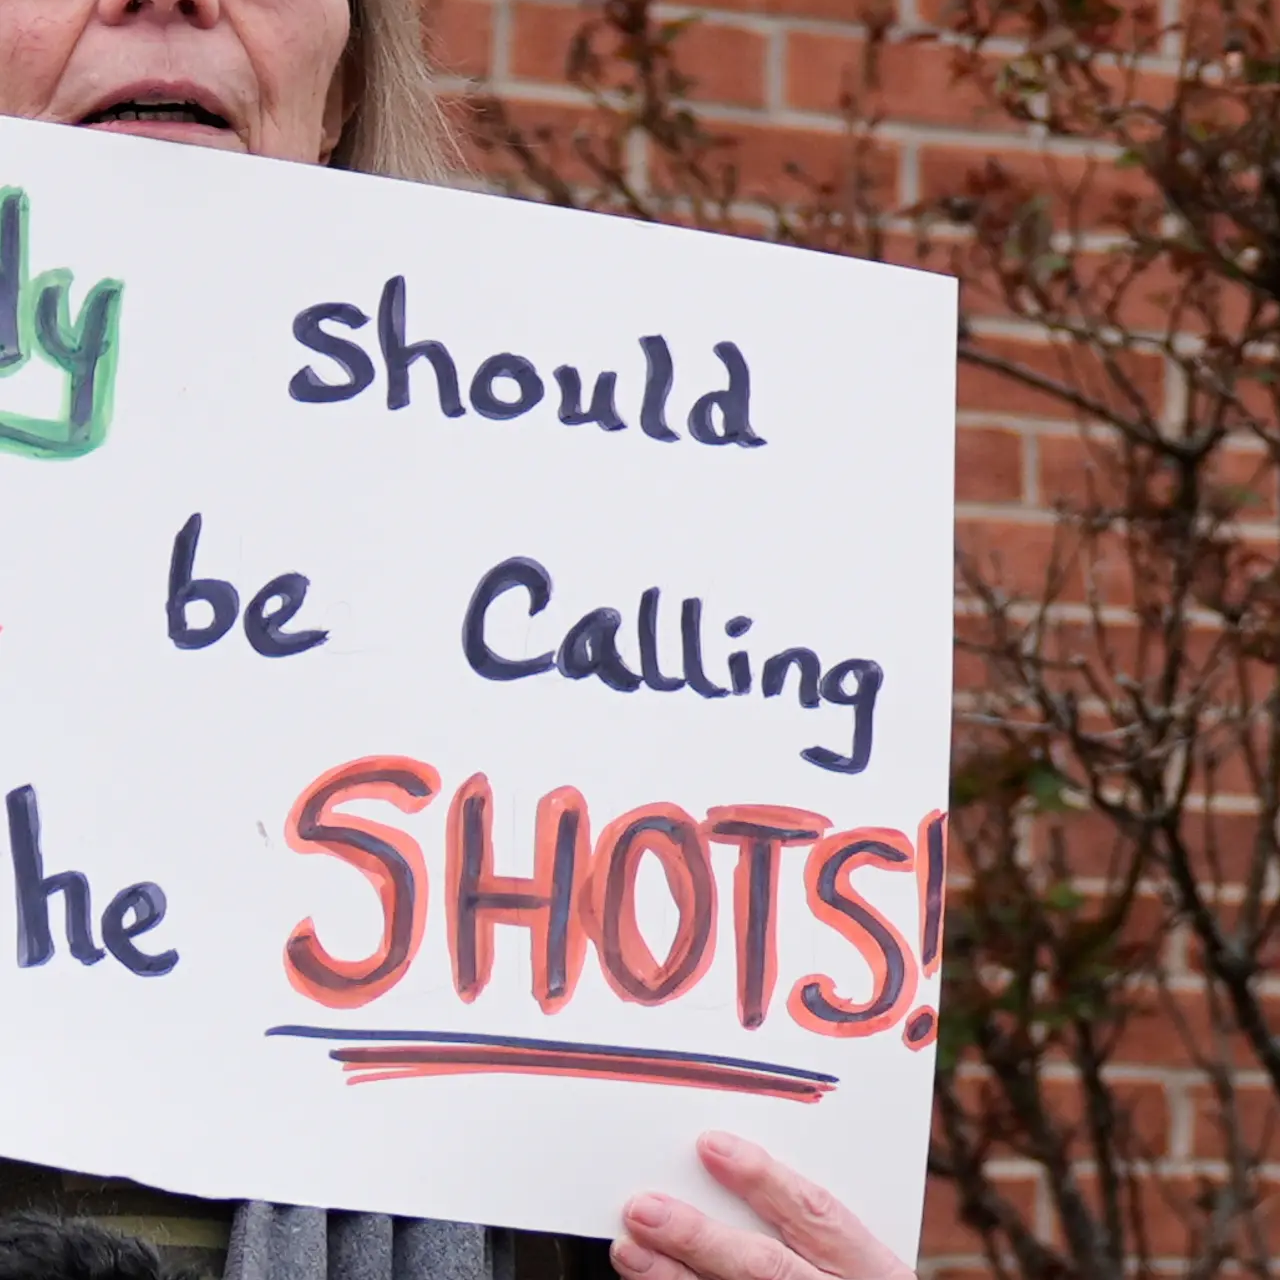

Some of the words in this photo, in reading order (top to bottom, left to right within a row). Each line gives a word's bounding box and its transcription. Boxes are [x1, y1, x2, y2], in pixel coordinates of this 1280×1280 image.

[166, 513, 329, 659] be
[463, 556, 884, 775] Calling
[5, 784, 180, 977] he
[284, 755, 948, 1051] SHOTS!
